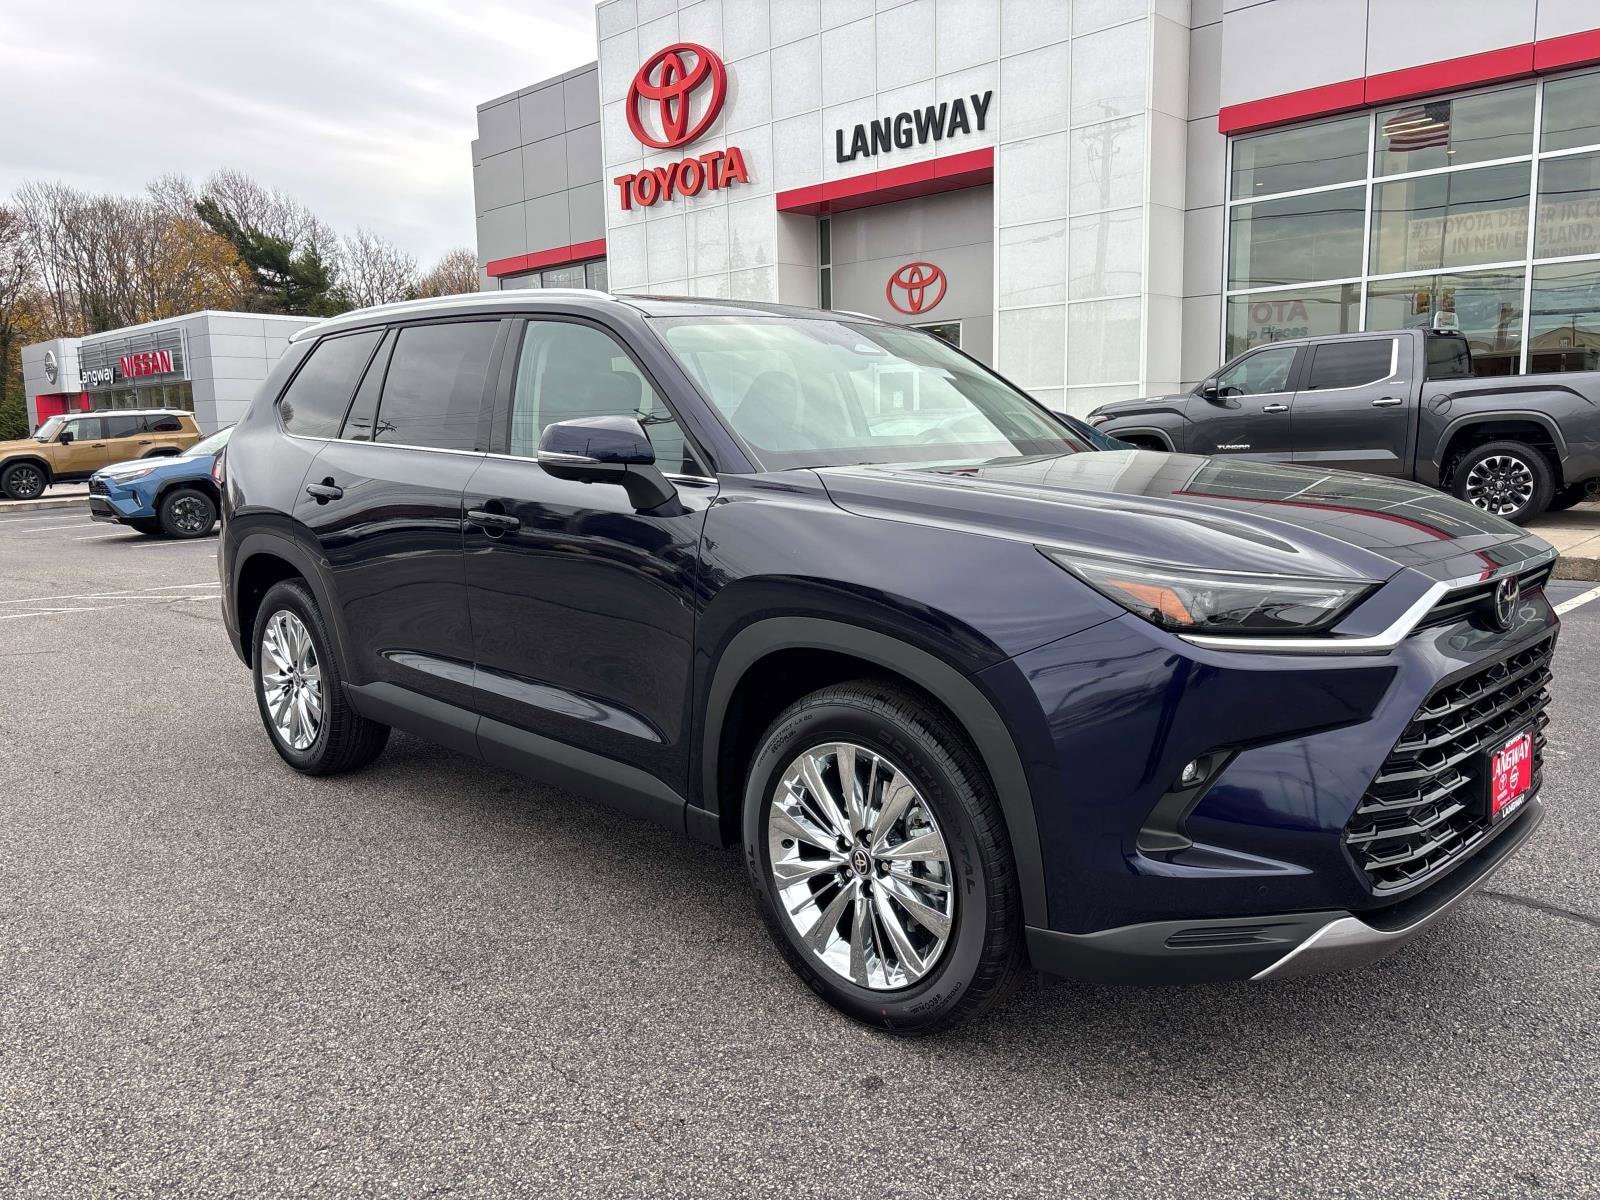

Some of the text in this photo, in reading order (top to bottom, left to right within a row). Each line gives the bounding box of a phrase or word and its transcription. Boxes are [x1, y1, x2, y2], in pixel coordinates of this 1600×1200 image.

[836, 90, 993, 163] LANGWAY
[614, 147, 750, 211] TOYOTA
[1452, 236, 1470, 254] IN
[1474, 231, 1509, 251] NEW
[79, 350, 174, 386] Langway NISSAN
